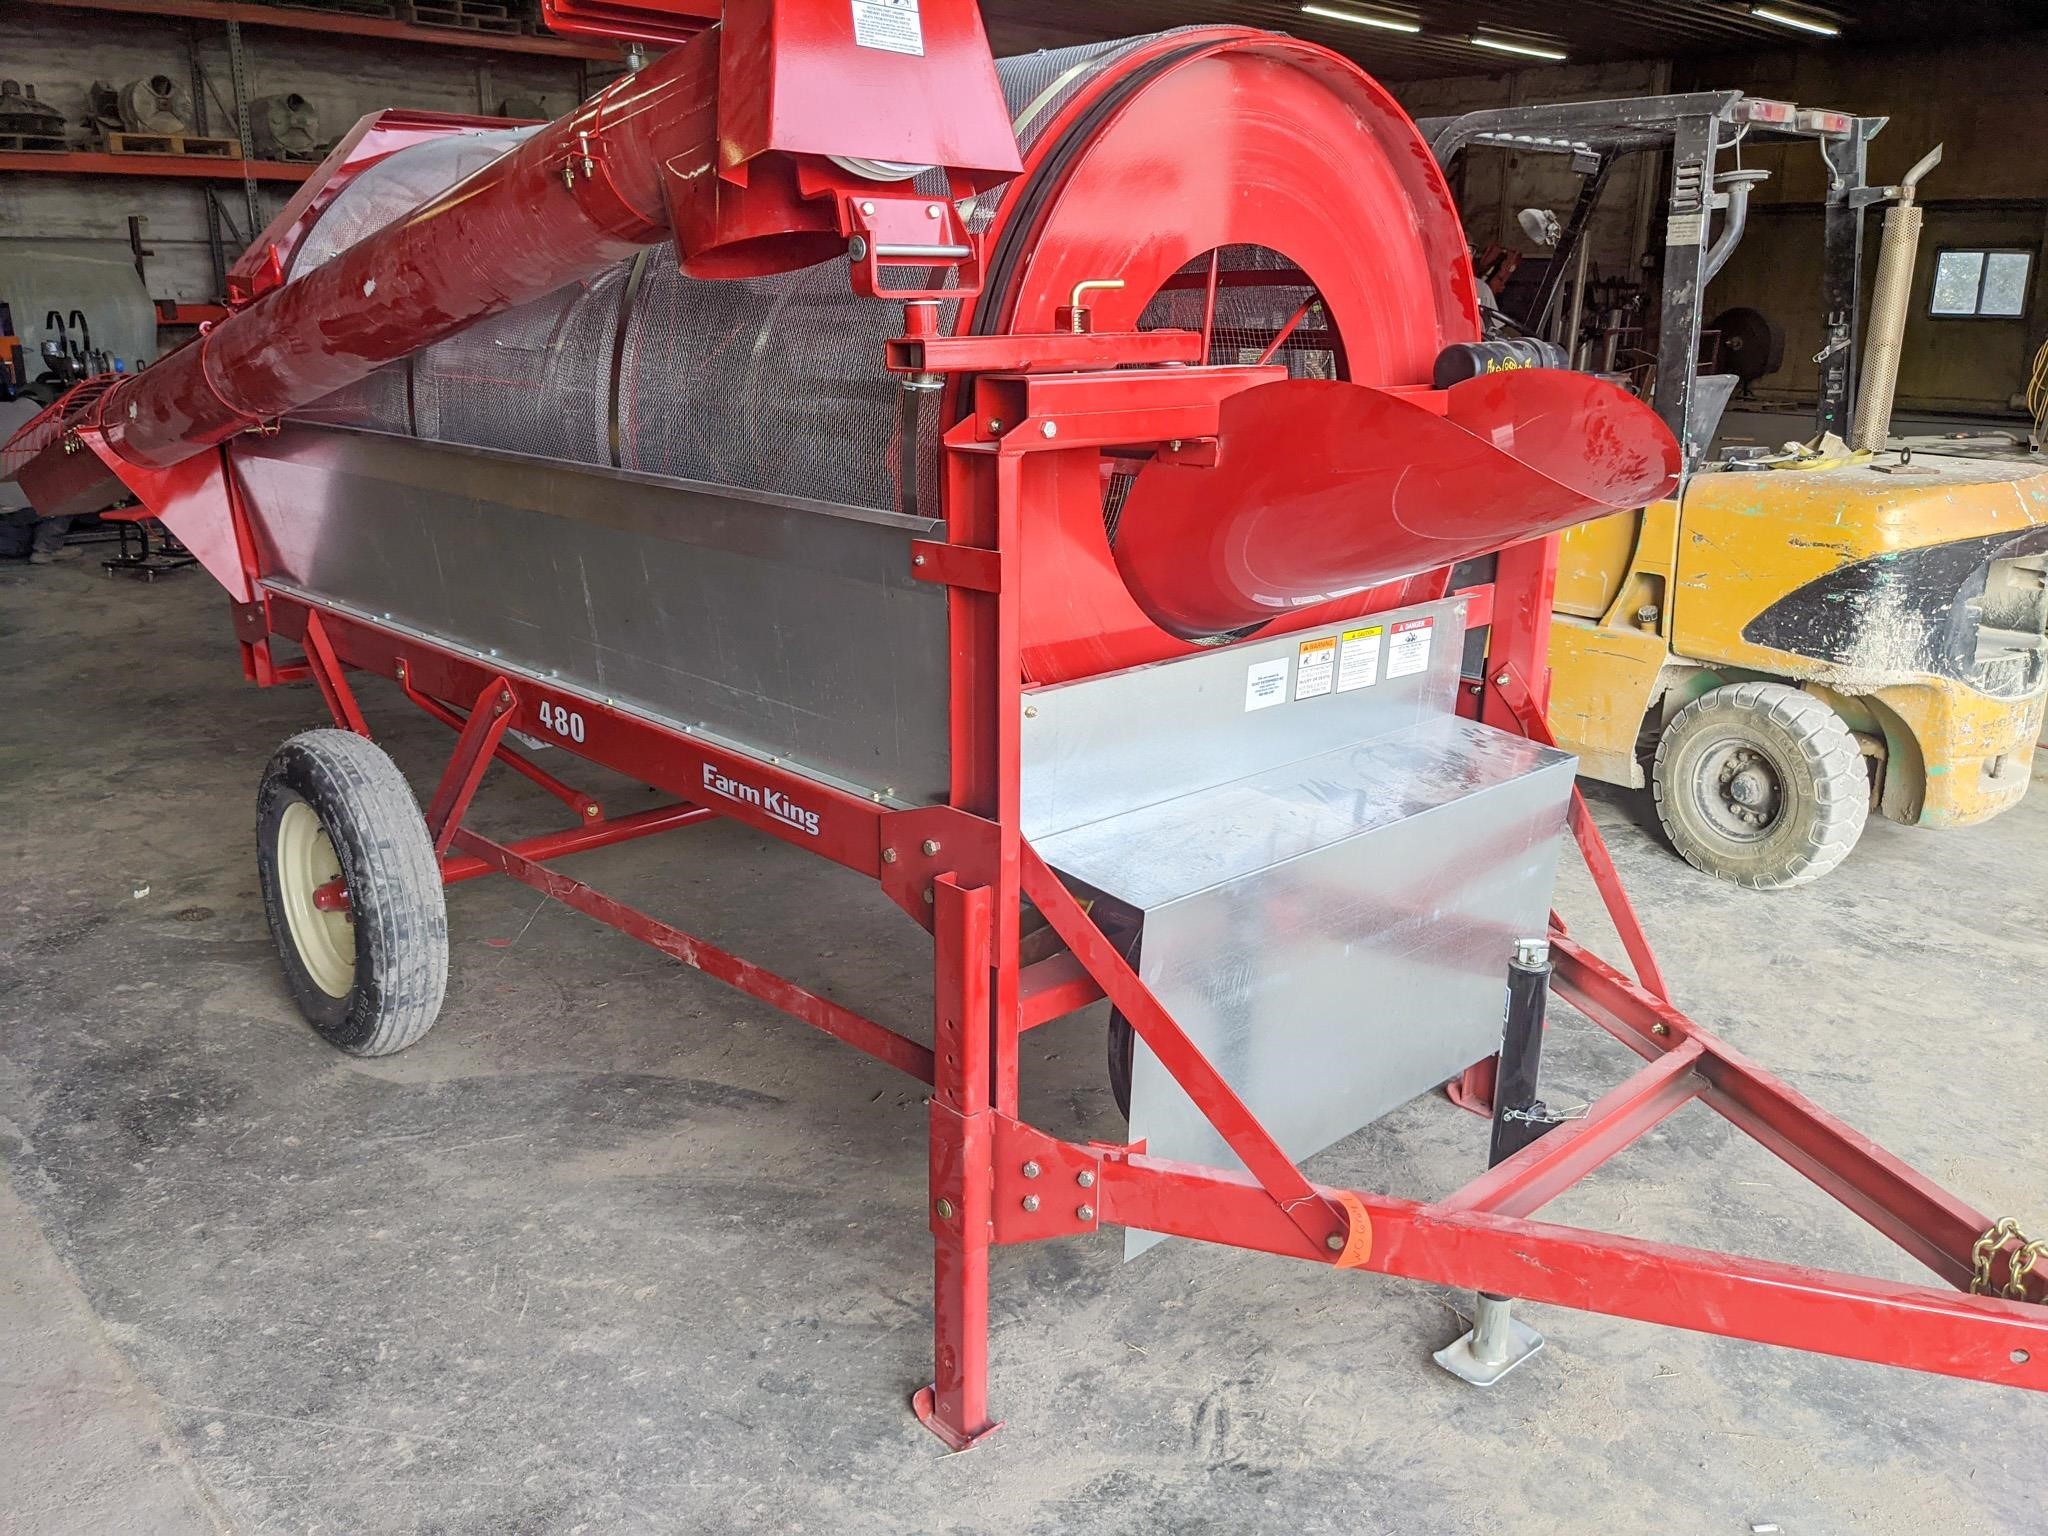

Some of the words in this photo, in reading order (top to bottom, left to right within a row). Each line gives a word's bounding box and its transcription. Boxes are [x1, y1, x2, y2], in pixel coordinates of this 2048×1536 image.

[1405, 620, 1425, 630] DANGER
[1309, 639, 1334, 650] WARNING
[539, 700, 585, 743] 480
[702, 762, 761, 805] Farm
[764, 786, 820, 836] King
